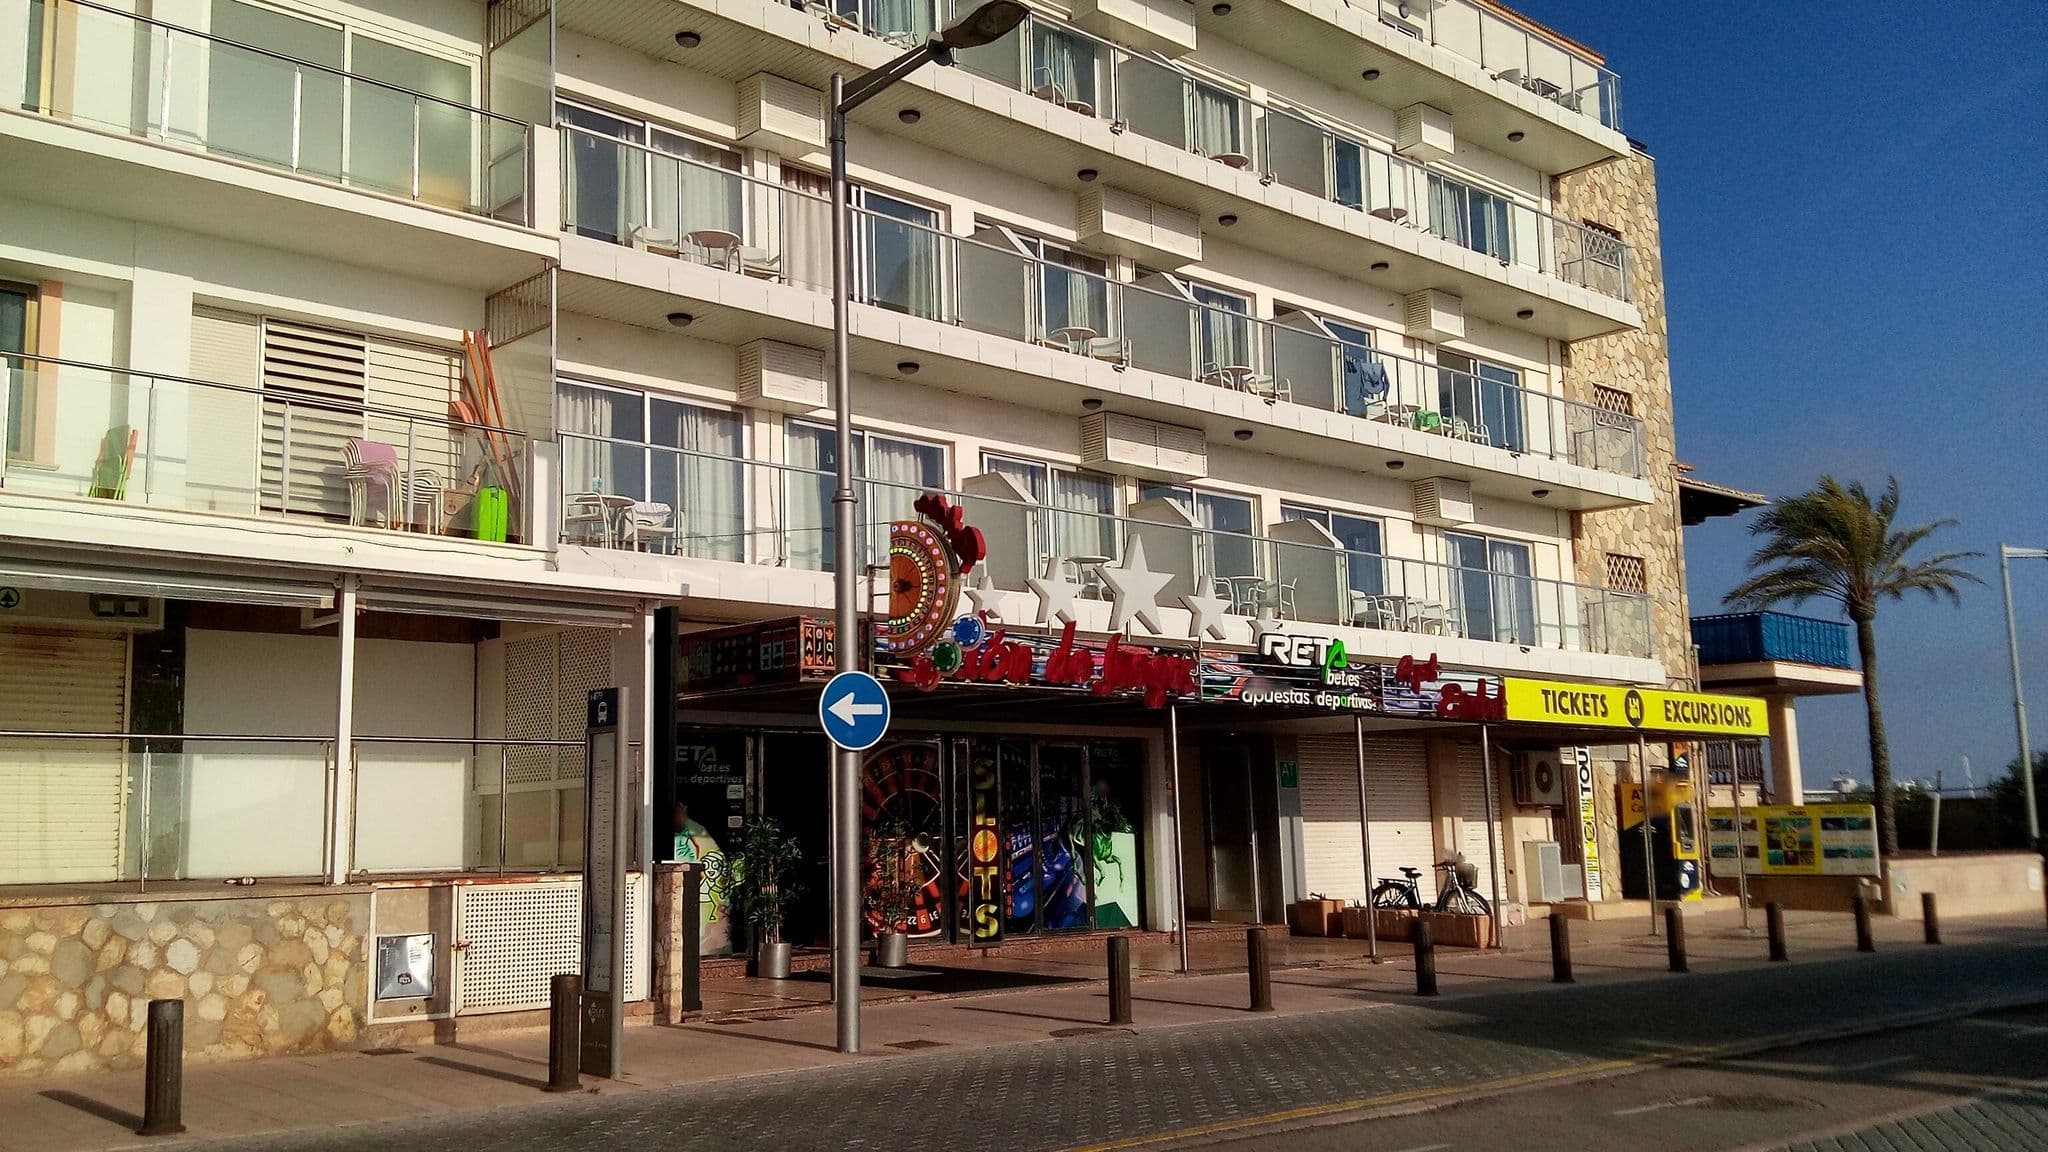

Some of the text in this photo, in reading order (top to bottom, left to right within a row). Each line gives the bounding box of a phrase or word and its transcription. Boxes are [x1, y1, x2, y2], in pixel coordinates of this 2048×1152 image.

[1260, 633, 1348, 681] RETA
[1316, 690, 1373, 711] deportivas
[1541, 688, 1609, 718] TICKETS
[1664, 699, 1752, 727] EXCURSIONS
[674, 745, 718, 766] ETA
[1281, 762, 1295, 777] AT
[1577, 746, 1591, 797] TOU
[972, 758, 999, 938] SLOTS
